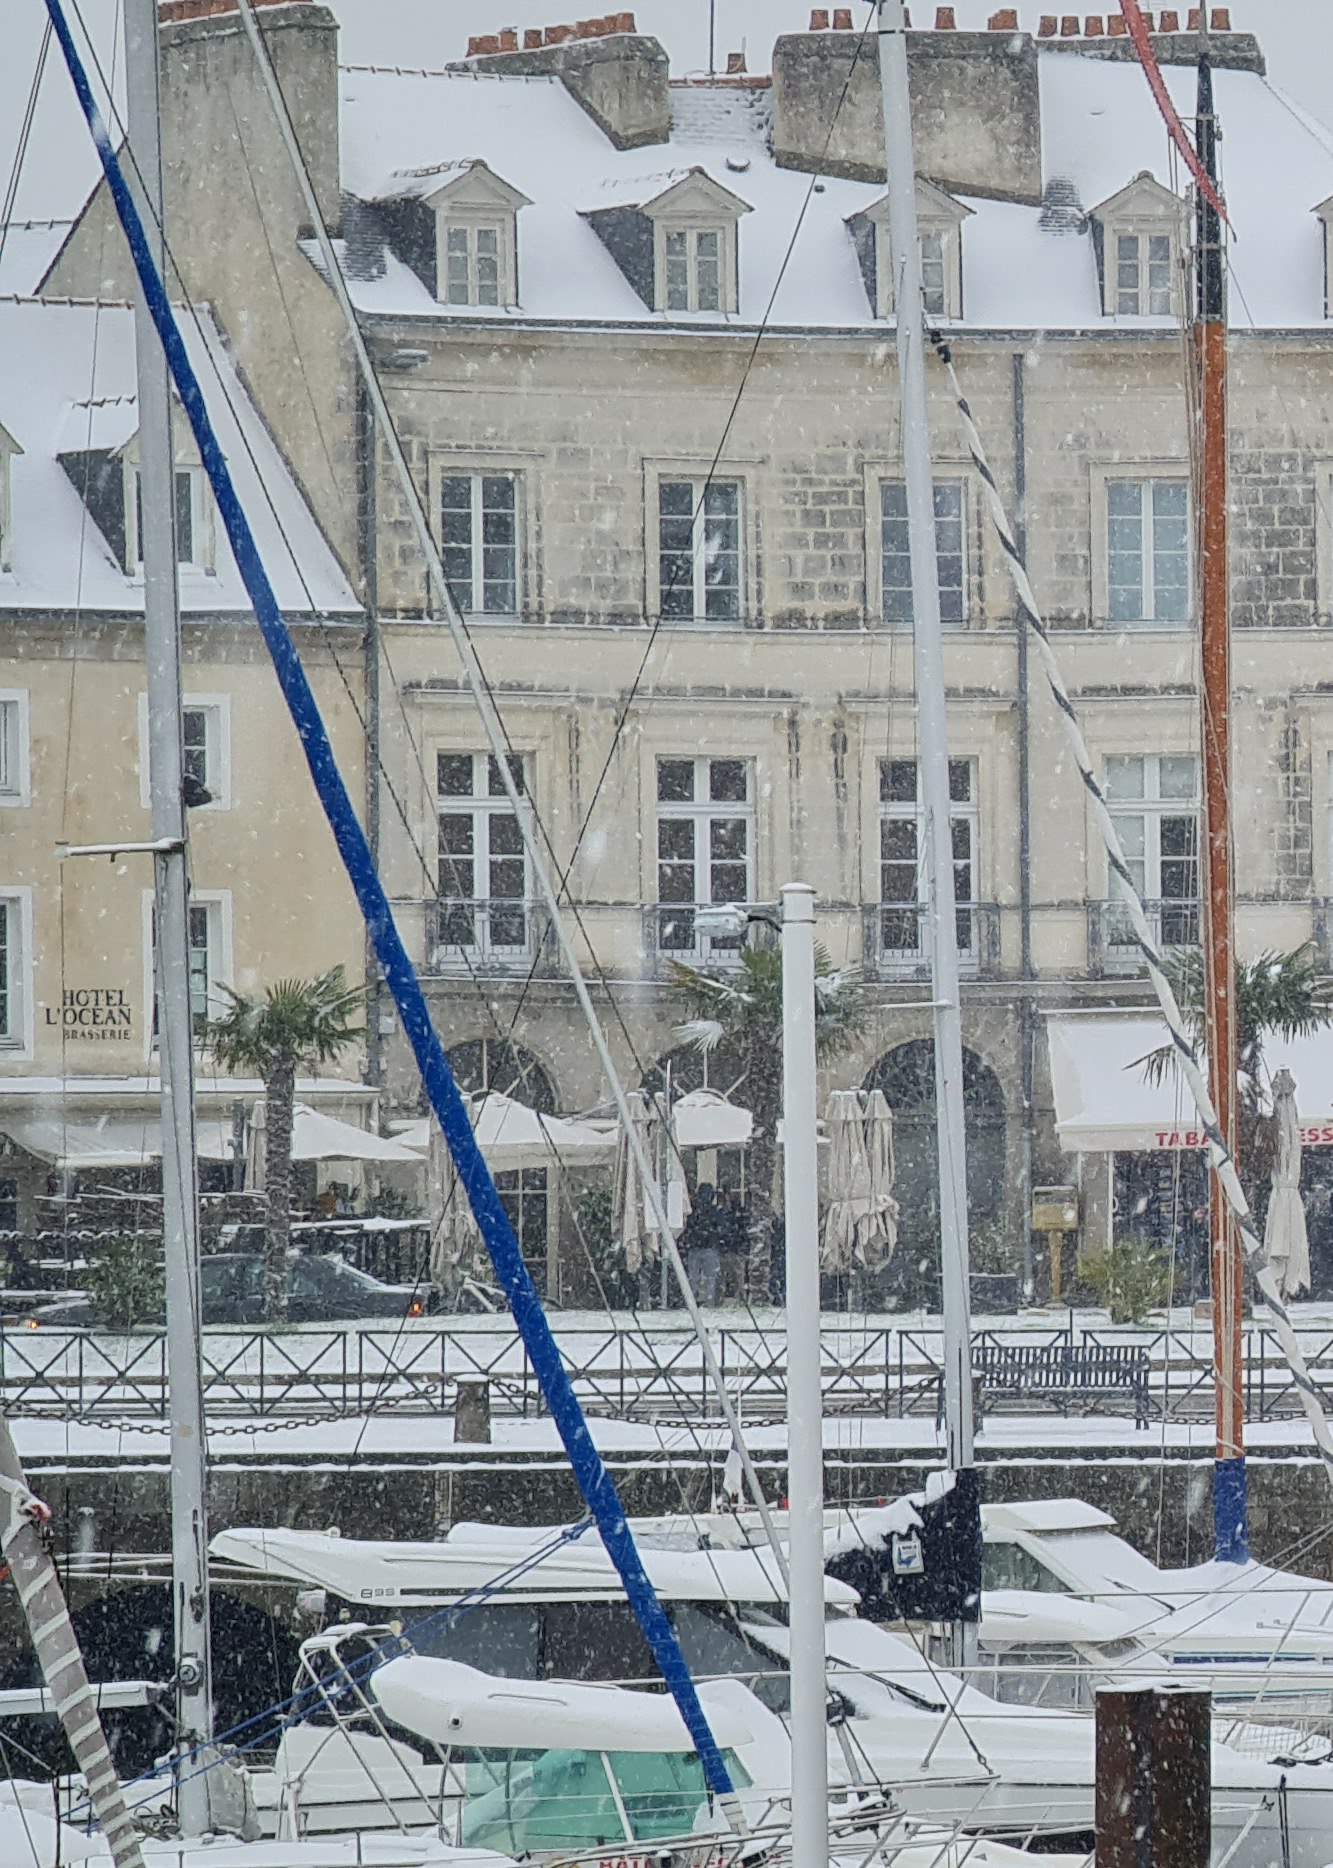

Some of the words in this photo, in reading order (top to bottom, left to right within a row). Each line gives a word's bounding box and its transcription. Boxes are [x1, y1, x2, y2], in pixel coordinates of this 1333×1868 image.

[63, 989, 129, 1006] HOTEL
[45, 1008, 131, 1025] L'OCEAN
[63, 1029, 131, 1040] BRASSERIE
[1155, 1131, 1209, 1147] TABA
